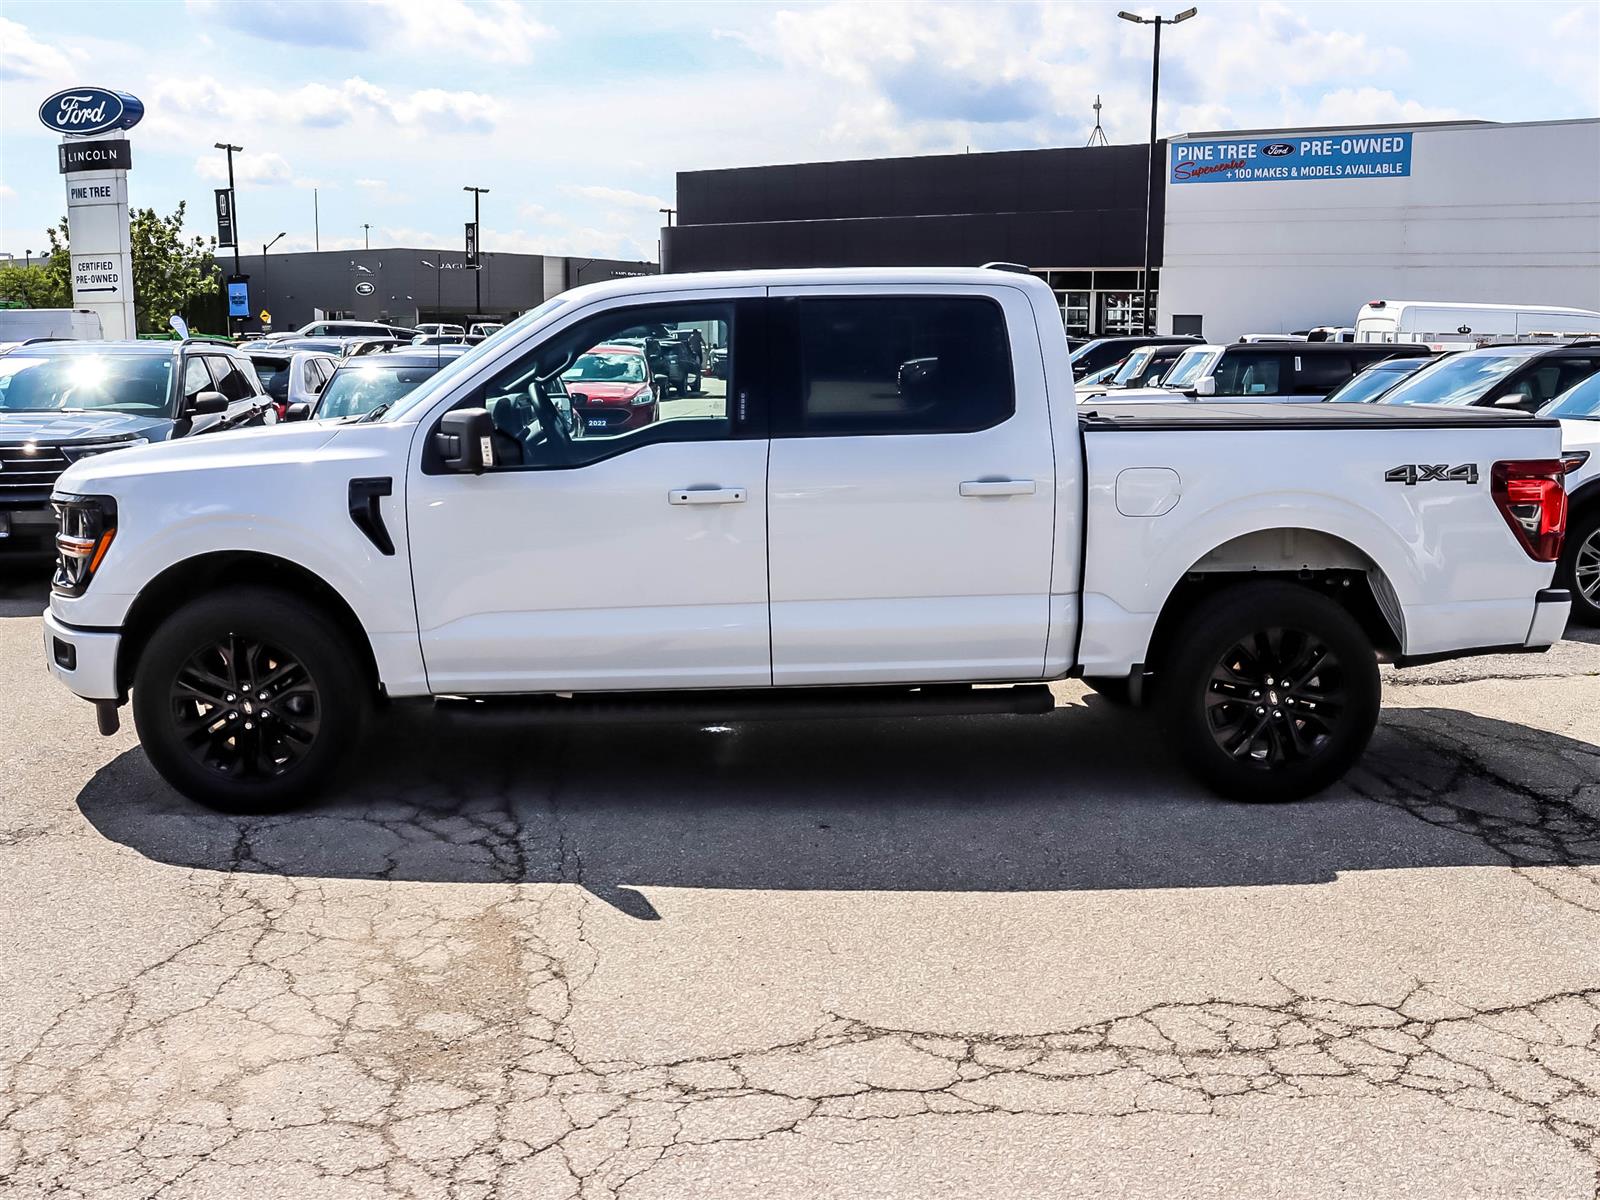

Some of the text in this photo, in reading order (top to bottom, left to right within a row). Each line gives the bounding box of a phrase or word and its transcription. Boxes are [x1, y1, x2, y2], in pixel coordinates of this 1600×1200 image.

[57, 95, 106, 125] Ford
[68, 149, 118, 163] LINCOLN
[1178, 137, 1404, 161] PINE TREE Ford PRE-OWNED
[1174, 159, 1246, 180] Supercentre
[1235, 168, 1252, 179] 100
[1254, 167, 1289, 178] MAKES
[1291, 166, 1298, 177] &
[1300, 165, 1343, 177] MODELS
[1344, 162, 1403, 175] AVAILABLE
[70, 186, 111, 200] PINE TREE
[78, 261, 113, 271] CERTIFIED
[439, 262, 483, 270] JAG
[76, 274, 119, 285] PRE-OWNED
